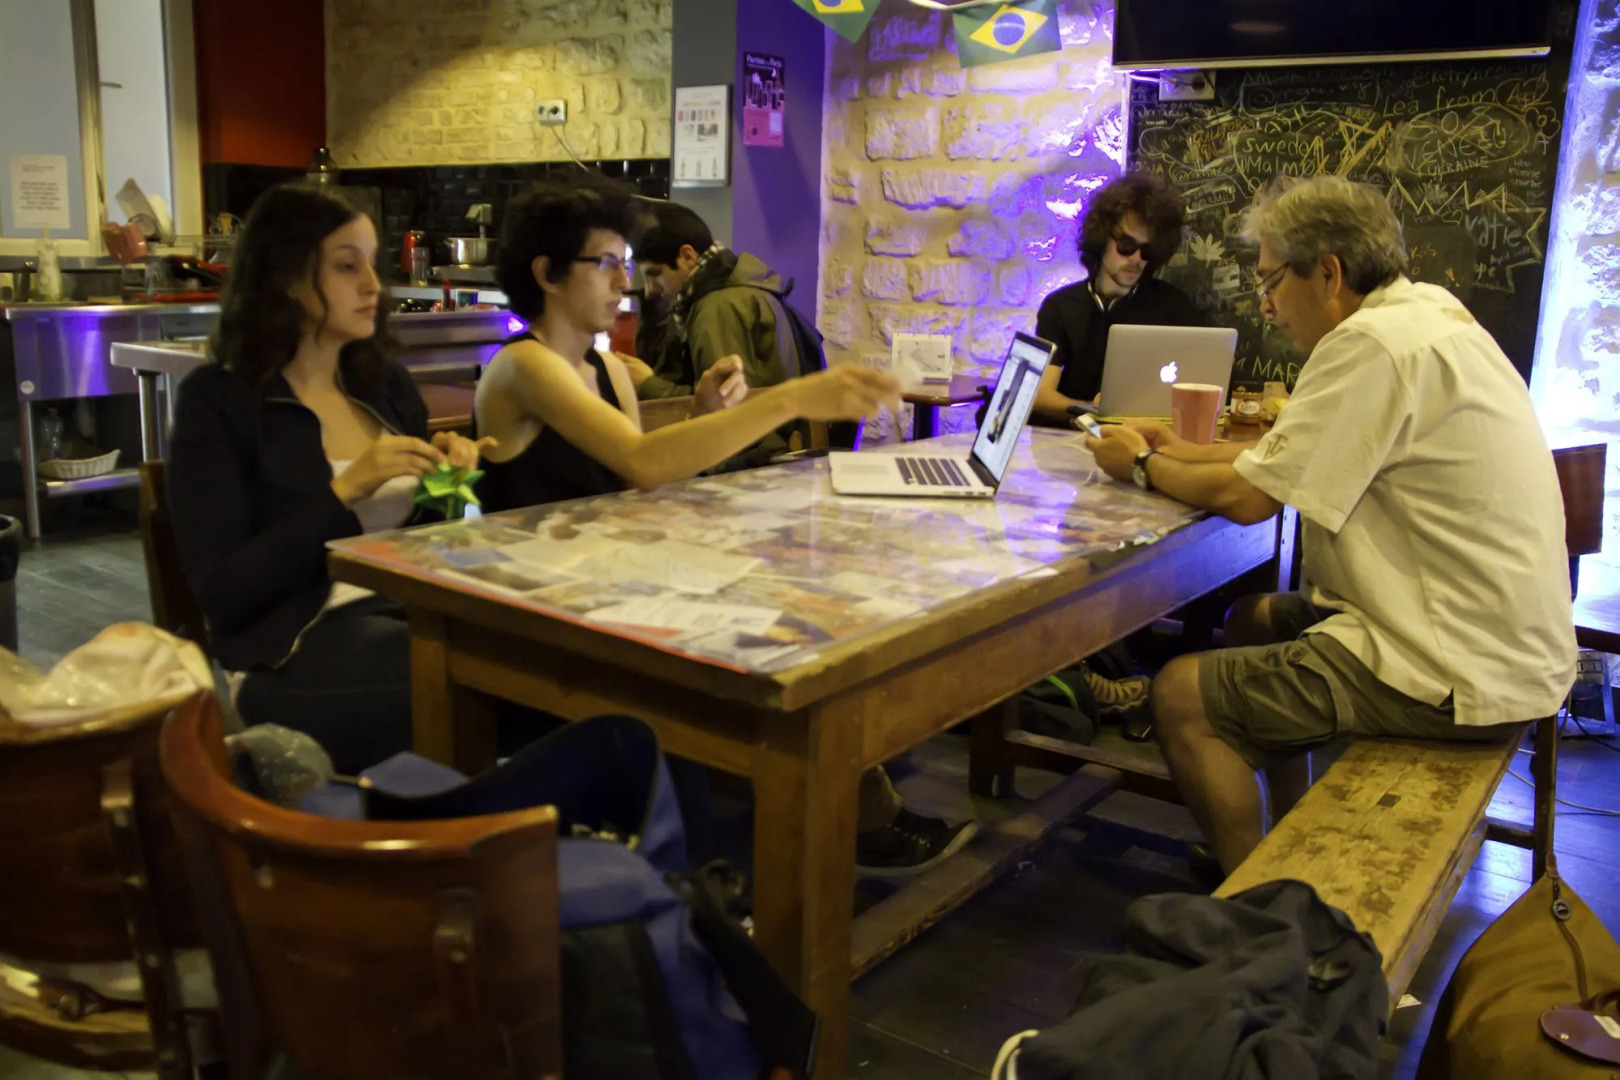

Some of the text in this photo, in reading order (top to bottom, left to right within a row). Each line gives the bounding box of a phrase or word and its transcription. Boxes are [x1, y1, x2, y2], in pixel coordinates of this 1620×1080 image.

[1383, 96, 1420, 117] Lea
[1437, 85, 1497, 115] from
[1427, 156, 1489, 179] UKRAINE
